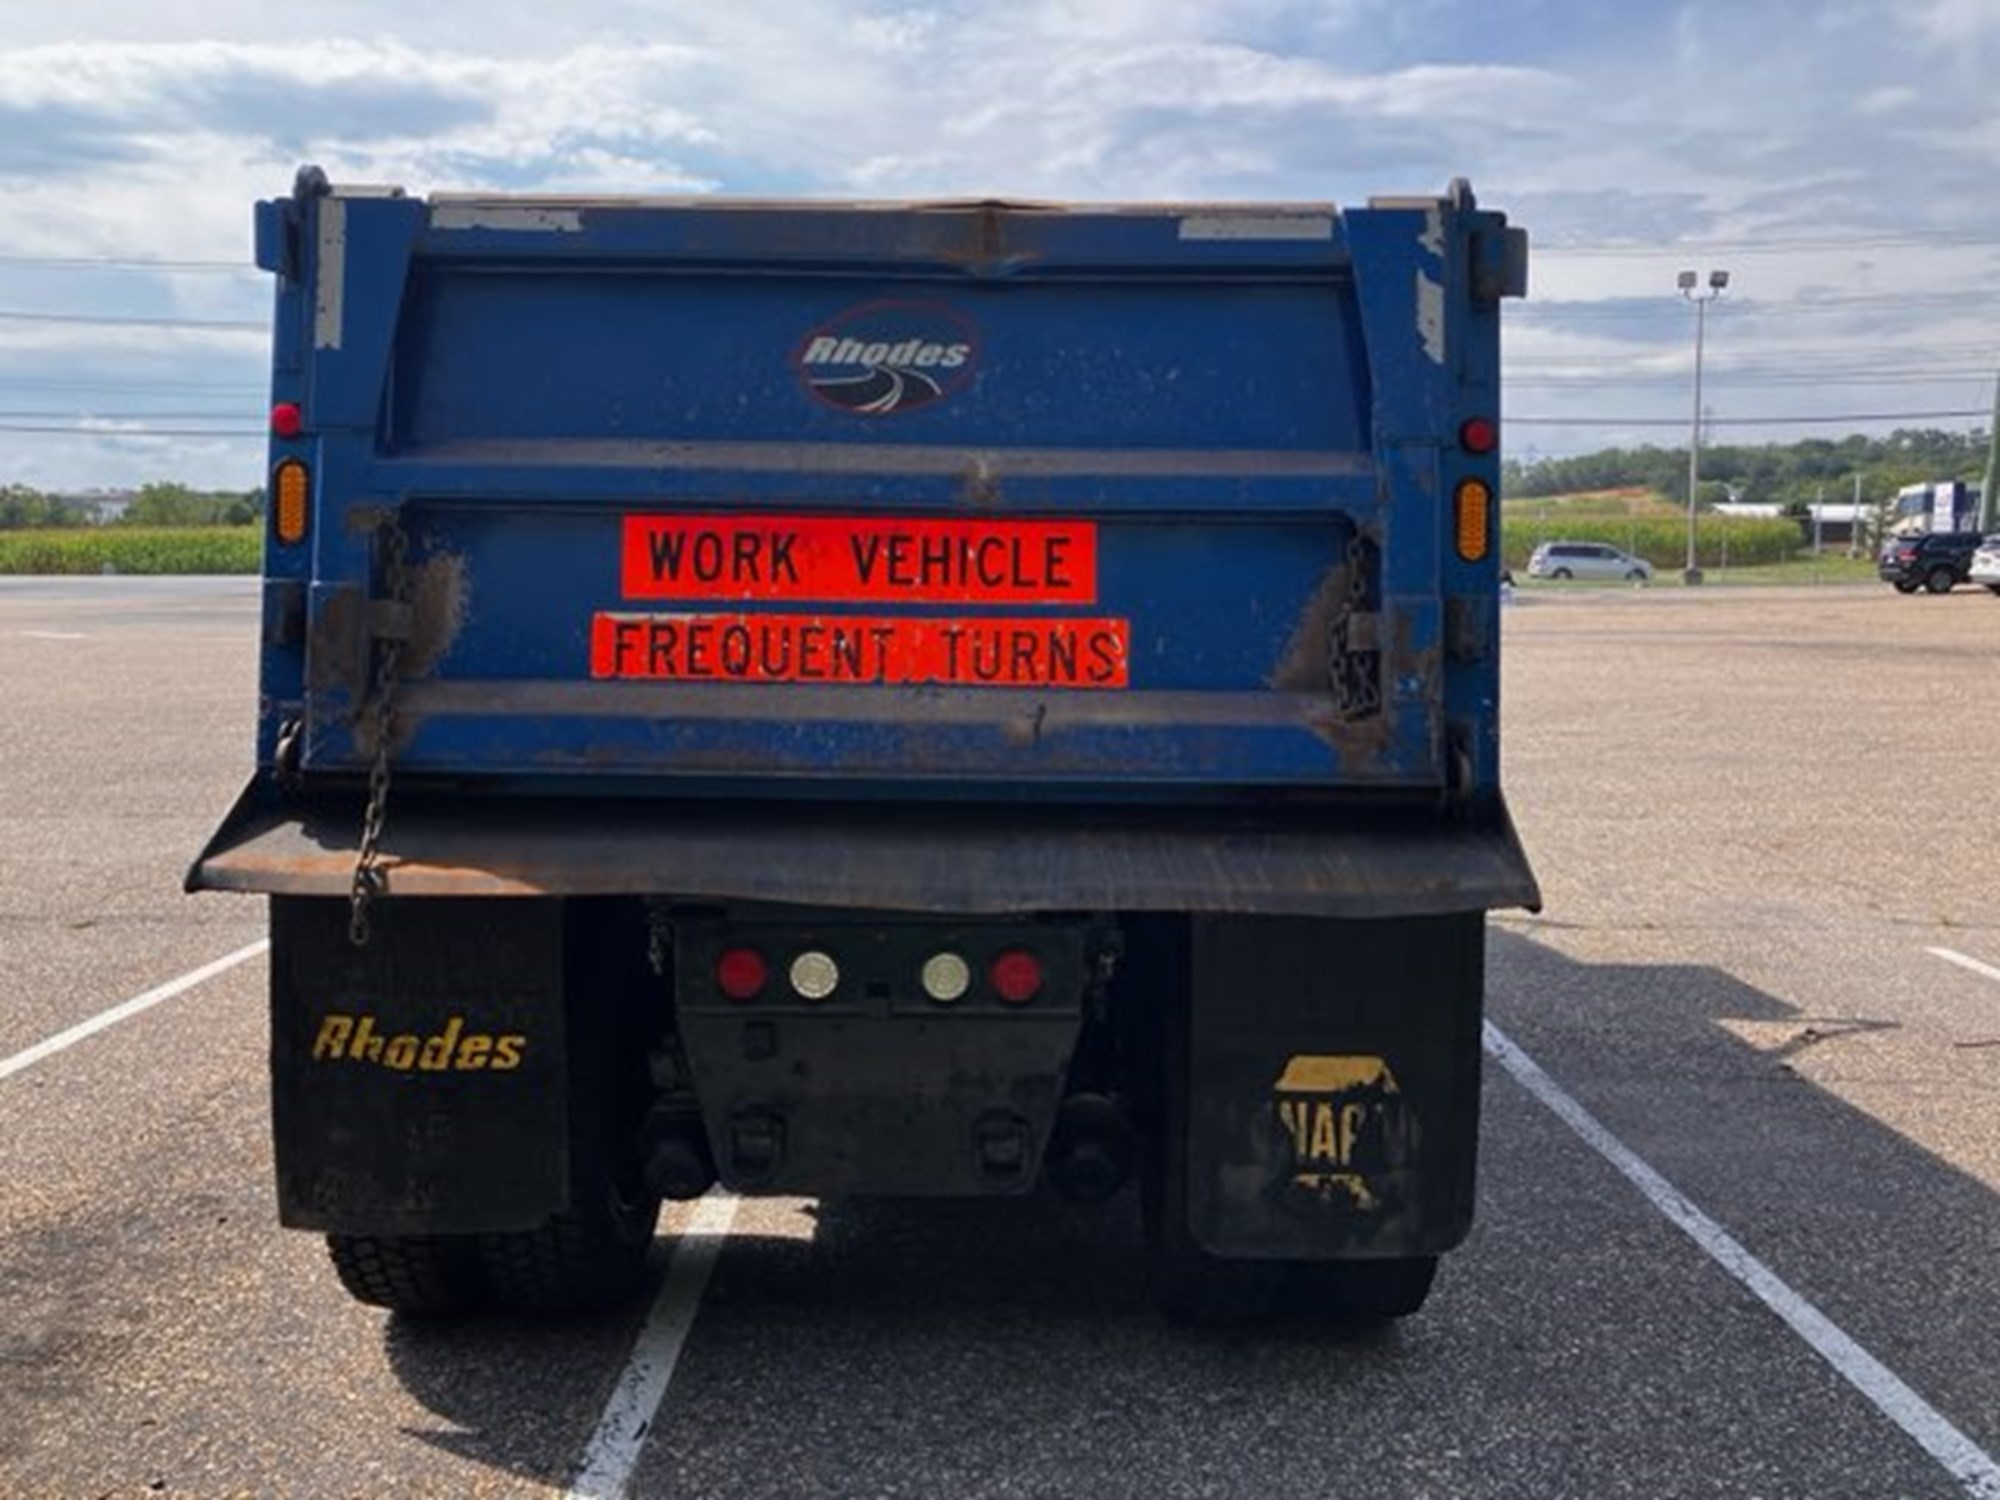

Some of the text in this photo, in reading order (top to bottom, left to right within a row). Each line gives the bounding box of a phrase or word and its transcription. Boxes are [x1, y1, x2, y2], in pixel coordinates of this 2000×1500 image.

[803, 335, 970, 368] Rhodes
[648, 530, 1072, 588] WORK VEHICLE
[613, 624, 1116, 683] FREQUENT TURNS
[312, 1014, 527, 1071] Rhodes
